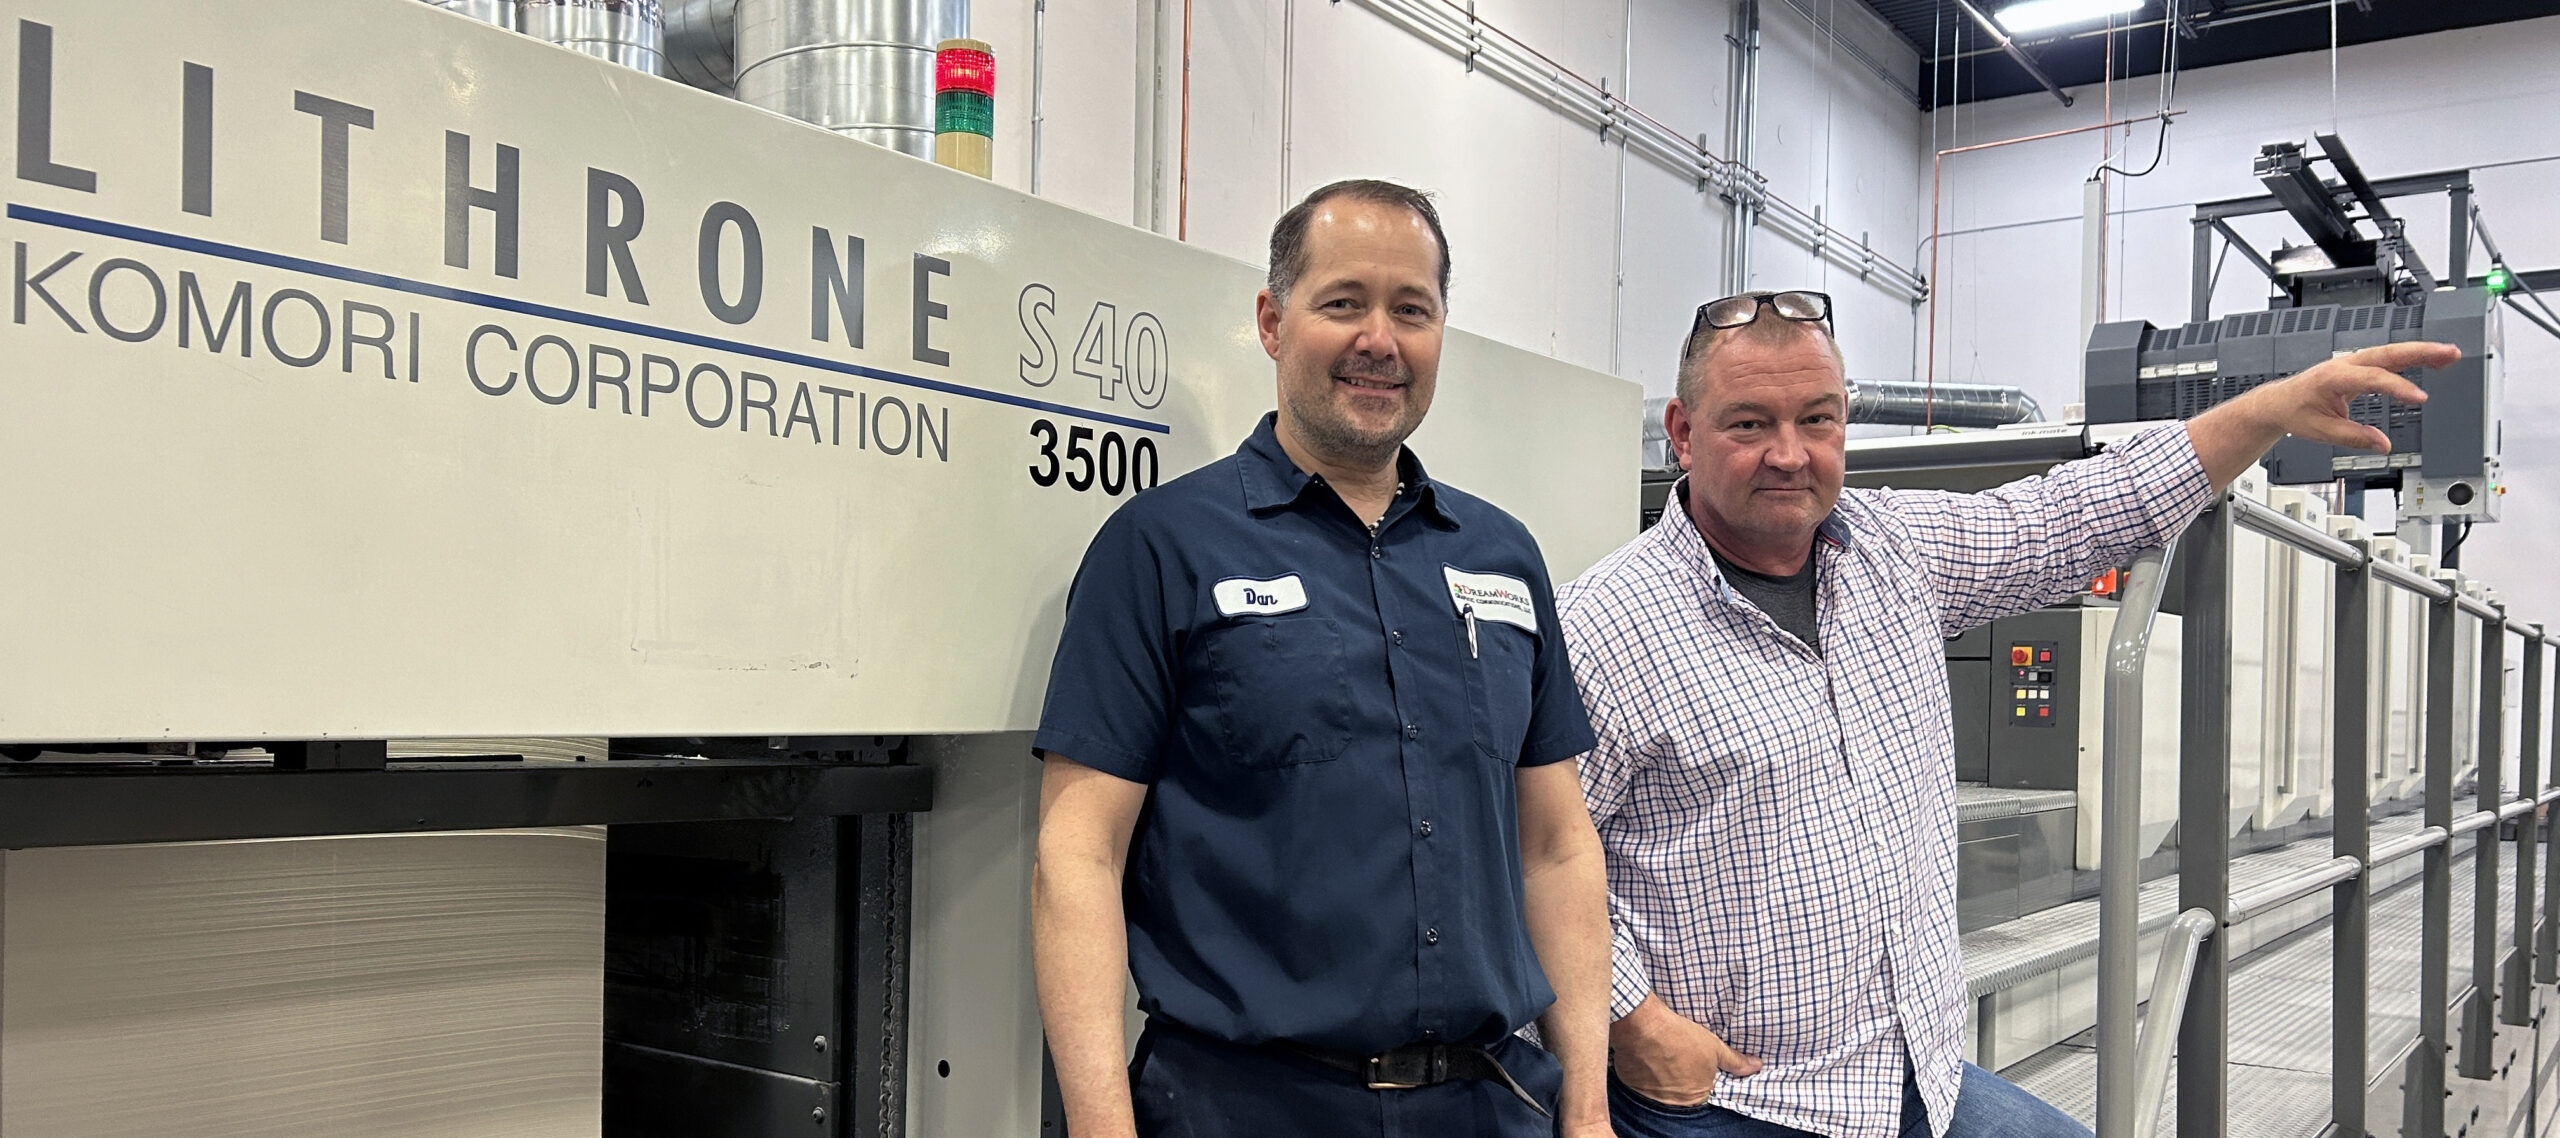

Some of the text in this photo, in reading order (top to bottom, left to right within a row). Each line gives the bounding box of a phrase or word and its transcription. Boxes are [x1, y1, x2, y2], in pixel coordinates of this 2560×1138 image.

[16, 18, 951, 368] LITHRONE
[12, 240, 949, 463] KOMORI CORPORATION
[1029, 419, 1160, 496] 3500
[1243, 587, 1278, 606] Dan
